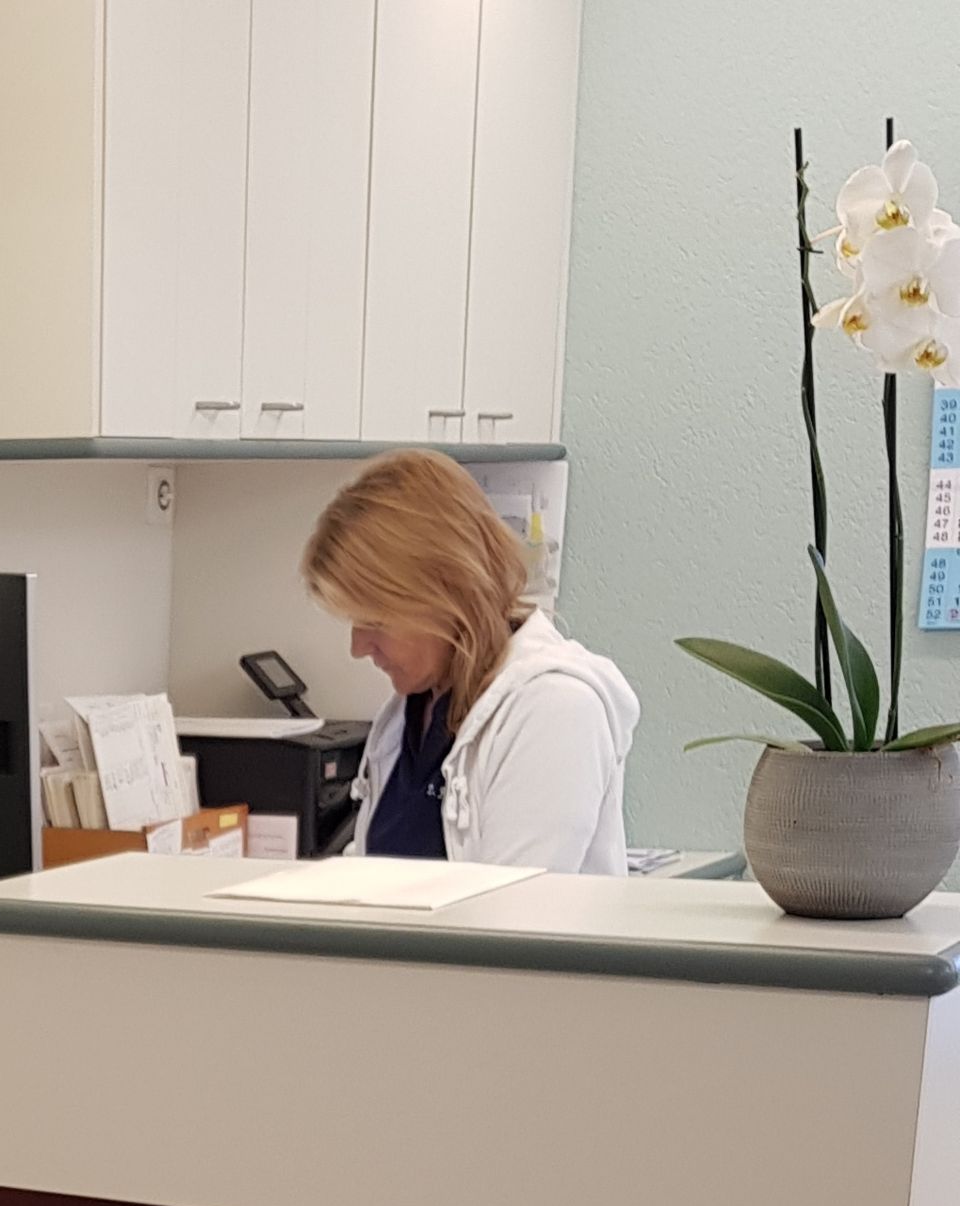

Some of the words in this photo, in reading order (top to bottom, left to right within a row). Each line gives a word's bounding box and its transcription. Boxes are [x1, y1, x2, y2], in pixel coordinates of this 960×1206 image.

[941, 399, 957, 411] 39
[940, 412, 956, 424] 40
[939, 426, 954, 436] 41
[939, 439, 954, 450] 42
[938, 452, 954, 464] 43
[936, 480, 951, 490] 44
[936, 493, 951, 503] 45
[935, 506, 951, 515] 46
[934, 519, 949, 528] 47
[933, 531, 948, 541] 48
[931, 558, 946, 569] 48
[930, 571, 945, 581] 49
[928, 584, 944, 594] 50
[928, 597, 941, 607] 51
[926, 608, 941, 619] 52
